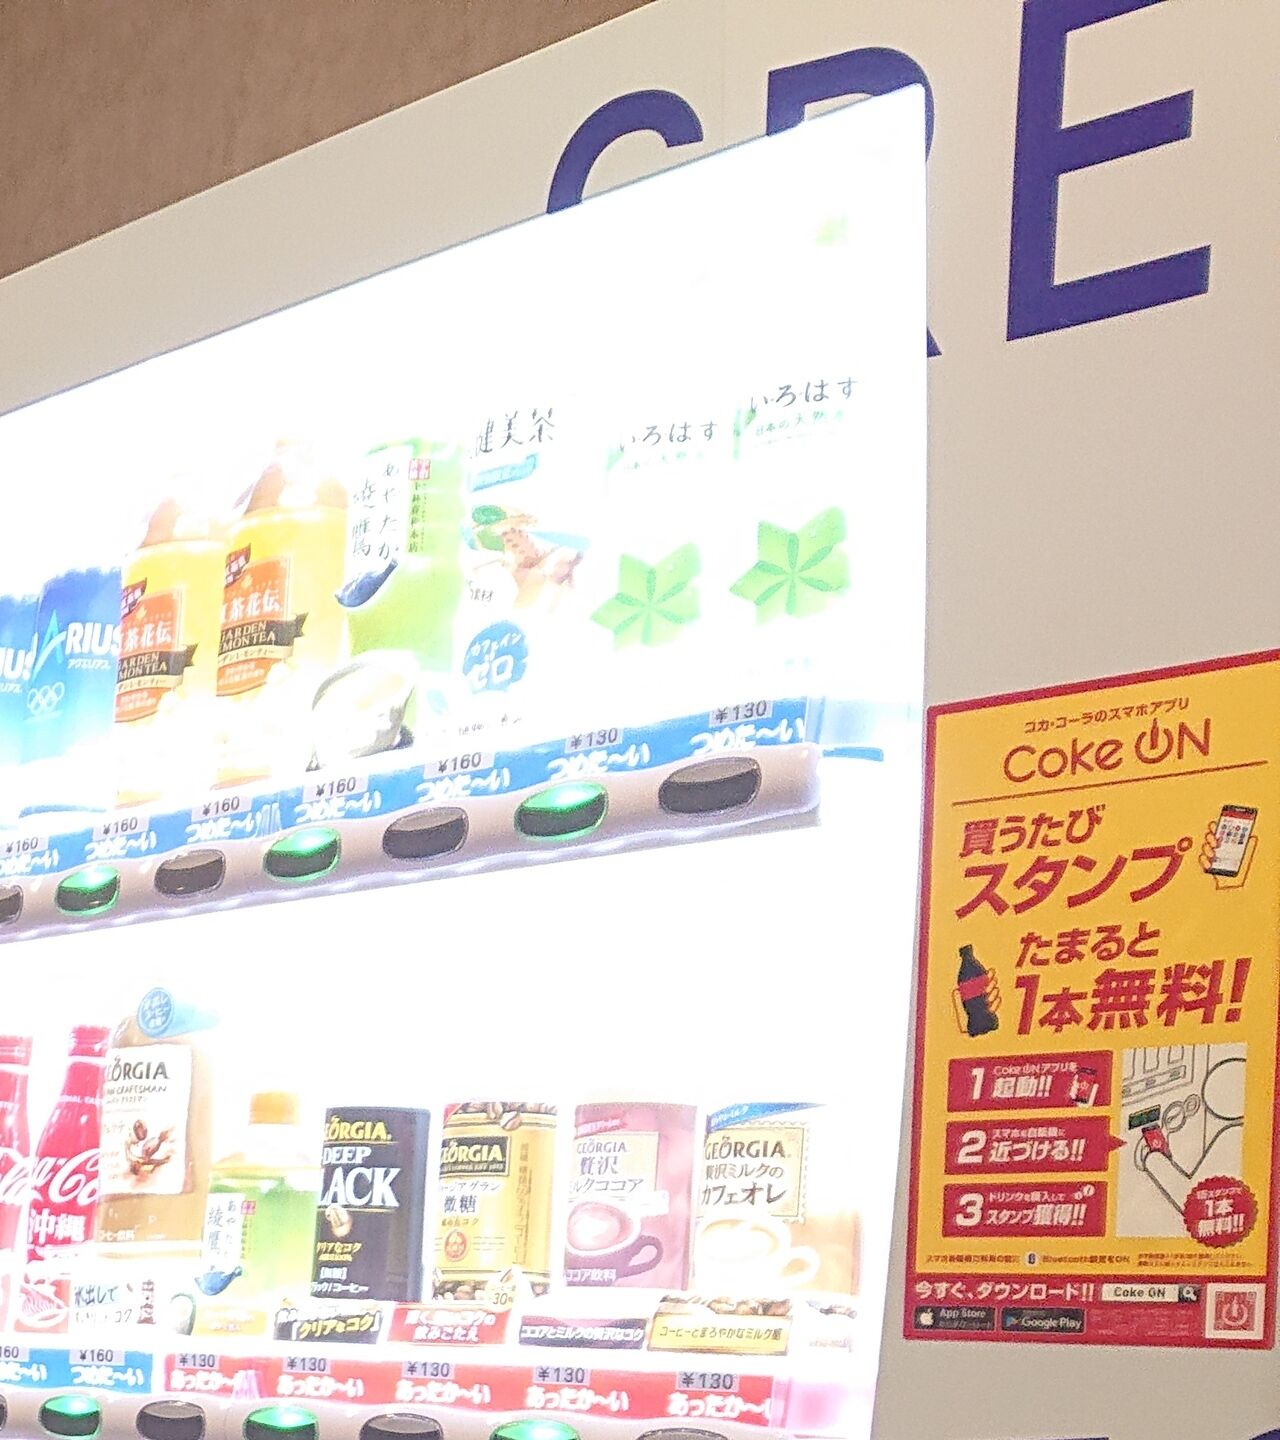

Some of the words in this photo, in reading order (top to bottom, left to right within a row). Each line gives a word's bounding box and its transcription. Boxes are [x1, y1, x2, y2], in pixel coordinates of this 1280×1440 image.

[469, 654, 515, 690] ゼロ
[713, 699, 767, 725] ¥130
[1024, 697, 1191, 735] コカ・コーラのスマホアプリ
[569, 726, 619, 750] ¥130
[1003, 737, 1124, 783] Coke
[1134, 717, 1212, 765] ON
[437, 752, 483, 773] ¥160
[315, 775, 357, 798] ¥160
[202, 796, 241, 814] ¥160
[102, 818, 138, 835] ¥160
[959, 803, 1107, 859] 買うたび
[5, 837, 40, 853] ¥160
[955, 836, 1194, 920] スタンプ
[1015, 921, 1161, 969] たまると
[1014, 957, 1253, 1036] 1本無料!
[971, 1067, 986, 1101] 1
[992, 1074, 1053, 1098] 起動!!
[323, 1146, 372, 1166] DEEP
[705, 1135, 790, 1160] GEORGIA
[957, 1129, 988, 1165] 2
[989, 1137, 1087, 1163] 近づける!!
[443, 1193, 478, 1214] 微糖
[701, 1182, 788, 1207] カフェオレ
[954, 1192, 985, 1228] 3
[986, 1203, 1088, 1227] スタンプ獲得!!
[28, 1208, 86, 1244] 沖縄
[914, 1280, 1095, 1303] 今すぐ、ダウンロード!!
[1113, 1286, 1146, 1299] Coke
[1148, 1286, 1167, 1299] ON
[939, 1308, 959, 1320] App
[961, 1308, 987, 1319] Store
[1021, 1316, 1059, 1331] Google
[1060, 1316, 1083, 1330] Play
[79, 1348, 114, 1364] ¥160
[178, 1353, 216, 1369] ¥130
[286, 1356, 327, 1374] ¥130
[406, 1361, 451, 1380] ¥130
[537, 1366, 586, 1387] ¥130
[681, 1371, 734, 1392] ¥130
